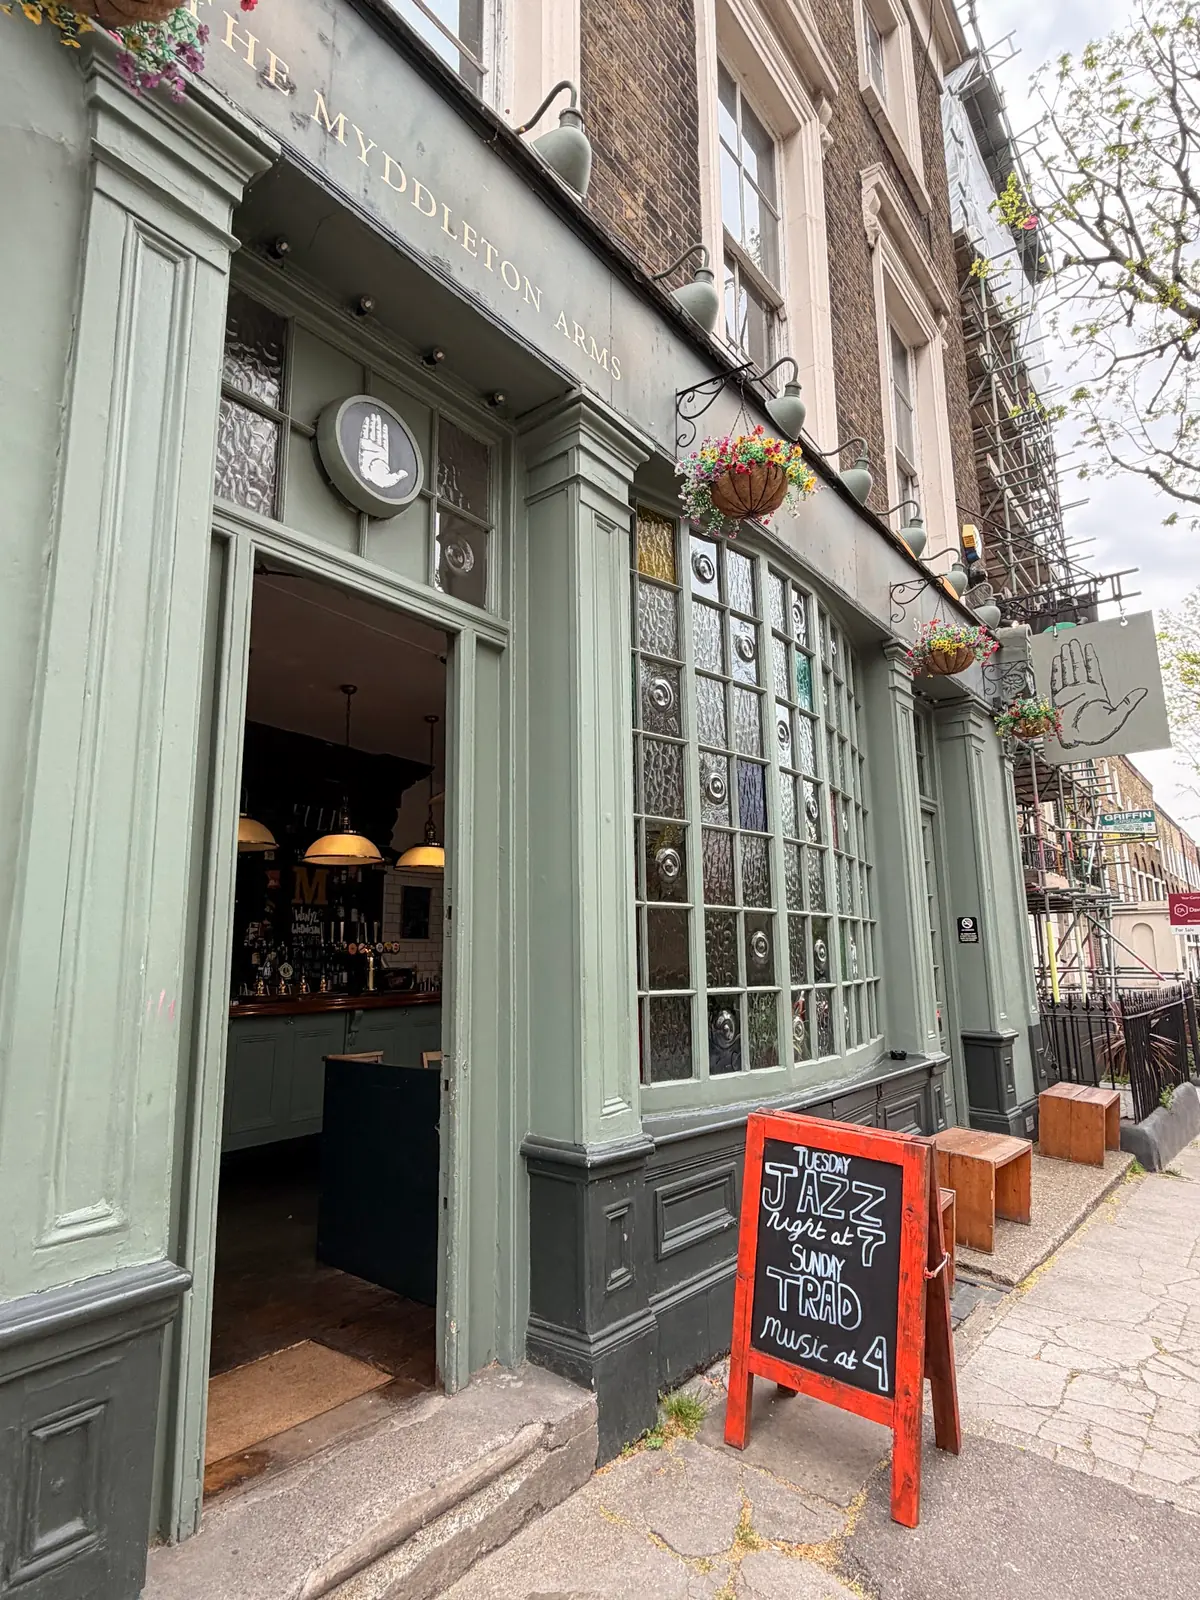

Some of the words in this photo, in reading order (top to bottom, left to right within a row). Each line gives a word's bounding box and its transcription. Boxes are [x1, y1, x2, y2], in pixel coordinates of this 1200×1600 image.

[310, 90, 543, 313] MYDDLETON
[553, 310, 622, 381] ARMS
[1104, 811, 1152, 821] GRIFFIN
[793, 1146, 852, 1175] TUESDAY
[762, 1162, 886, 1227] JAZZ
[790, 1245, 845, 1282] SUNDAY
[831, 1229, 853, 1246] at
[857, 1227, 886, 1267] 7
[767, 1266, 862, 1330] TRAD
[835, 1351, 858, 1371] at
[862, 1336, 889, 1392] 4
